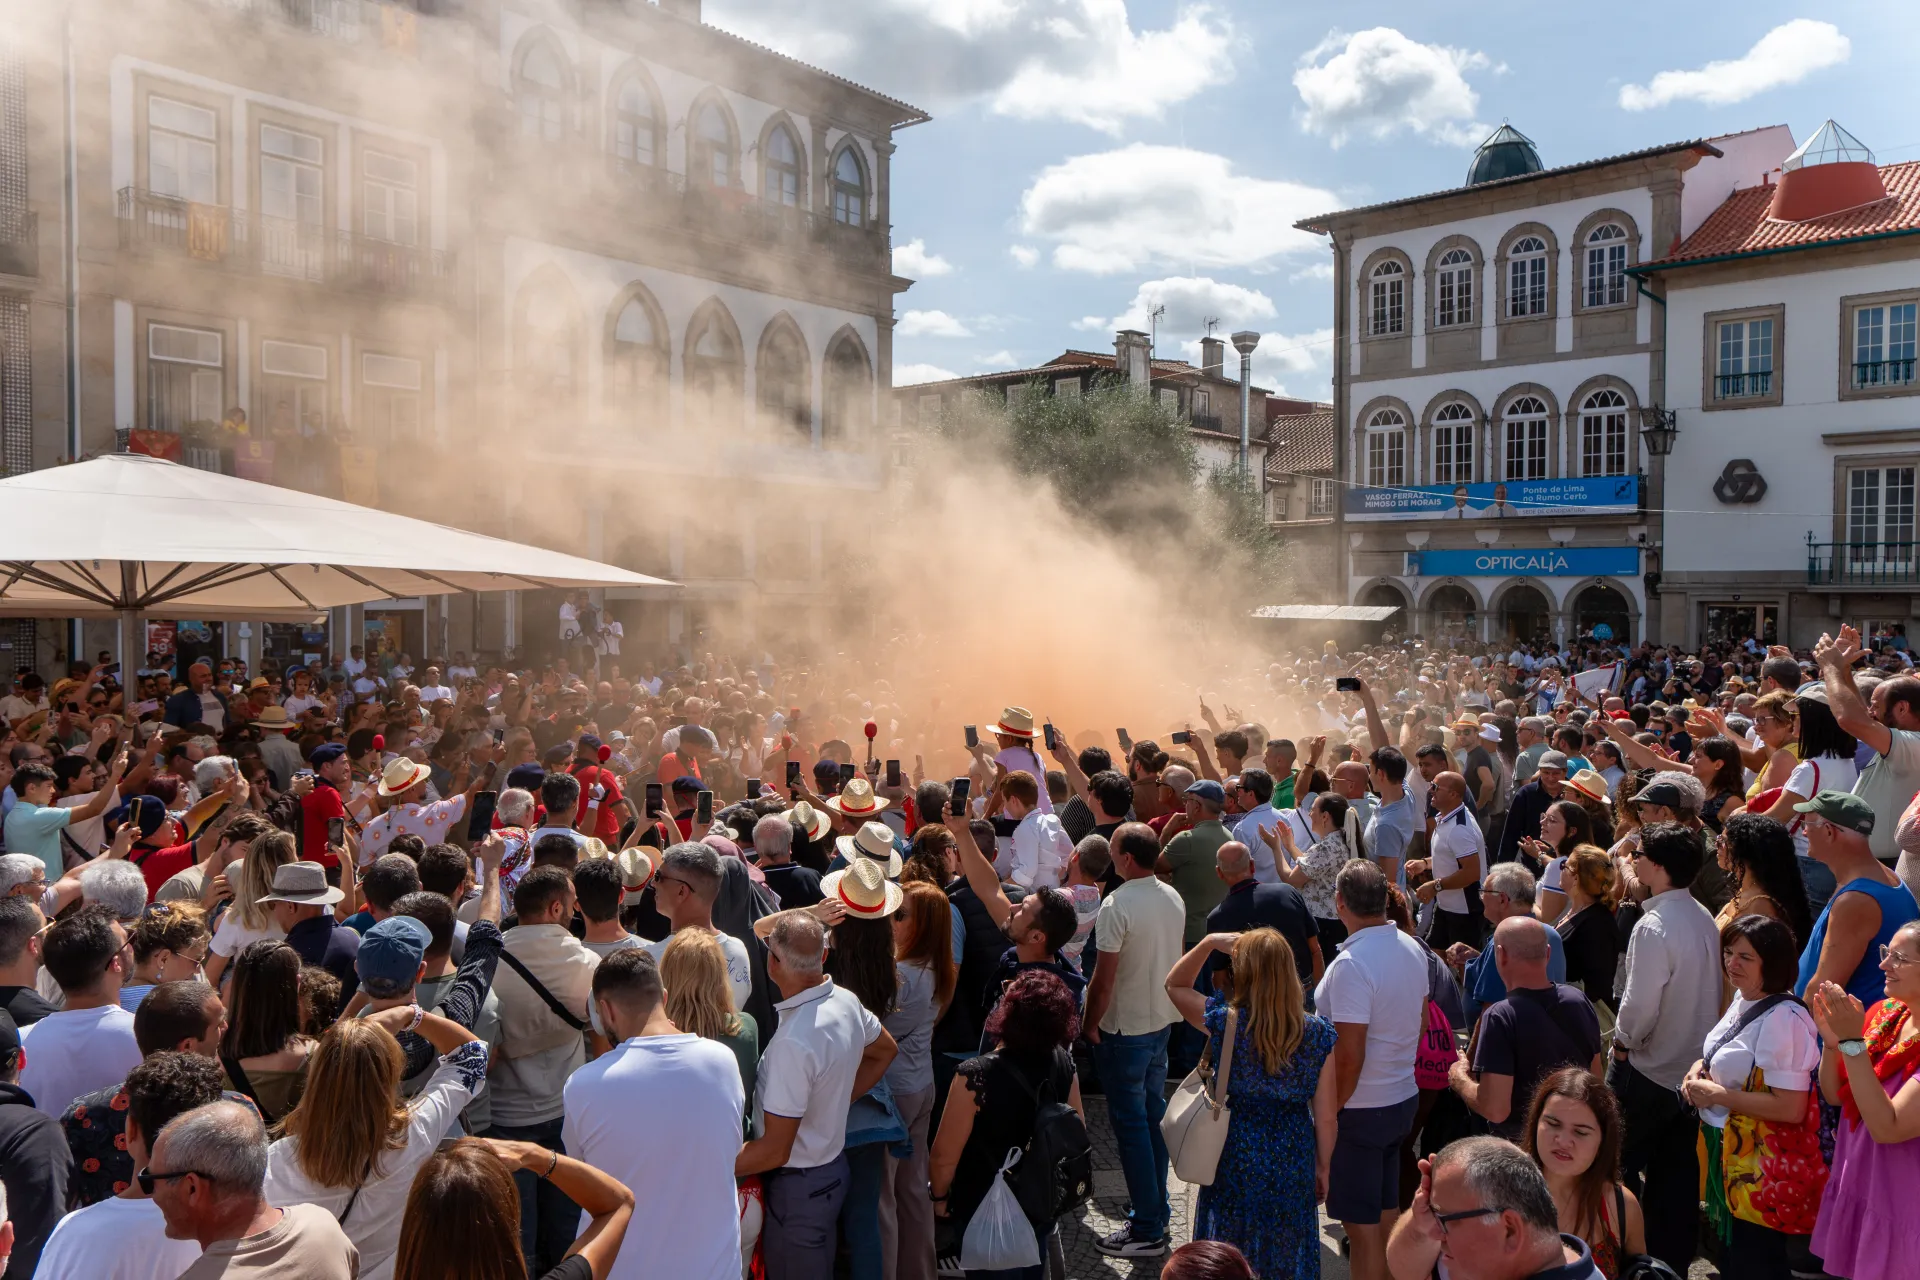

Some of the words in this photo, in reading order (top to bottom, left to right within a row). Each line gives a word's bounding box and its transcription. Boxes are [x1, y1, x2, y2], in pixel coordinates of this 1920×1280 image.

[1550, 485, 1561, 493] de
[1563, 484, 1585, 493] Lima
[1365, 493, 1391, 501] VASCO
[1393, 492, 1424, 500] FERRAZ
[1563, 492, 1588, 500] Certo
[1365, 500, 1396, 508] MIMOSO
[1398, 499, 1409, 507] DE
[1410, 498, 1442, 506] MORAIS
